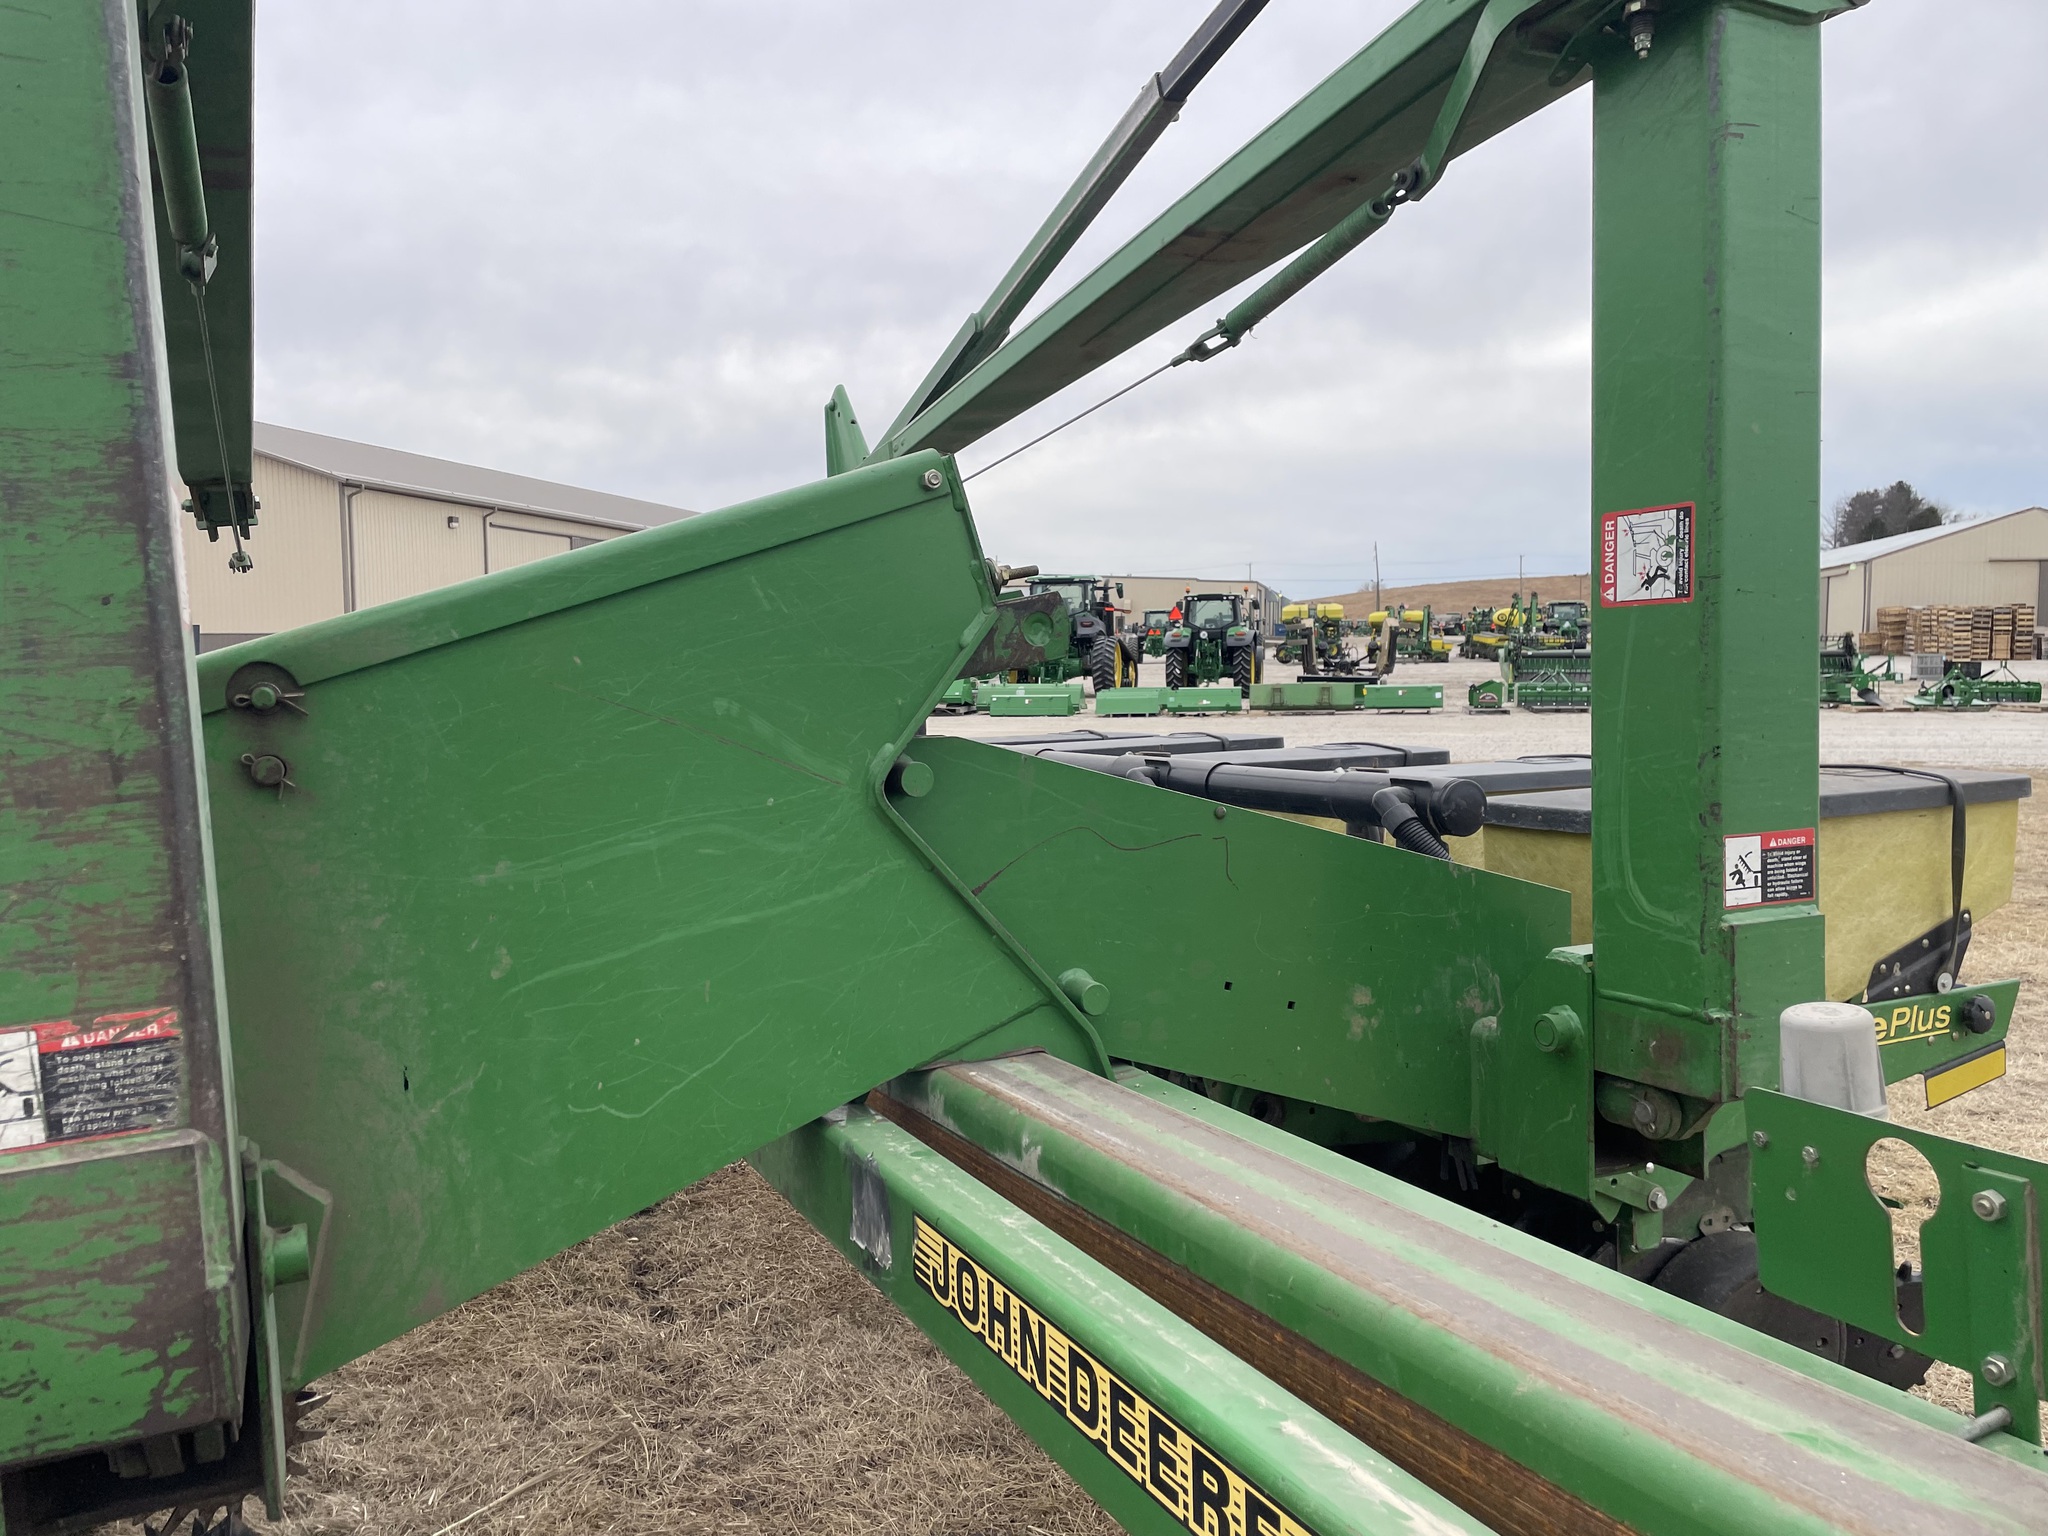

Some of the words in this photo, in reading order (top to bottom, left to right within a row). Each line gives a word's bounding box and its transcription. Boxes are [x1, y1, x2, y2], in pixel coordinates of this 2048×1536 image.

[1679, 511, 1685, 520] do
[1604, 520, 1615, 584] DANGER
[1777, 836, 1806, 846] DANGER
[95, 1058, 124, 1069] stand
[931, 1241, 1048, 1393] JOHN
[1066, 1342, 1282, 1536] DEERE
